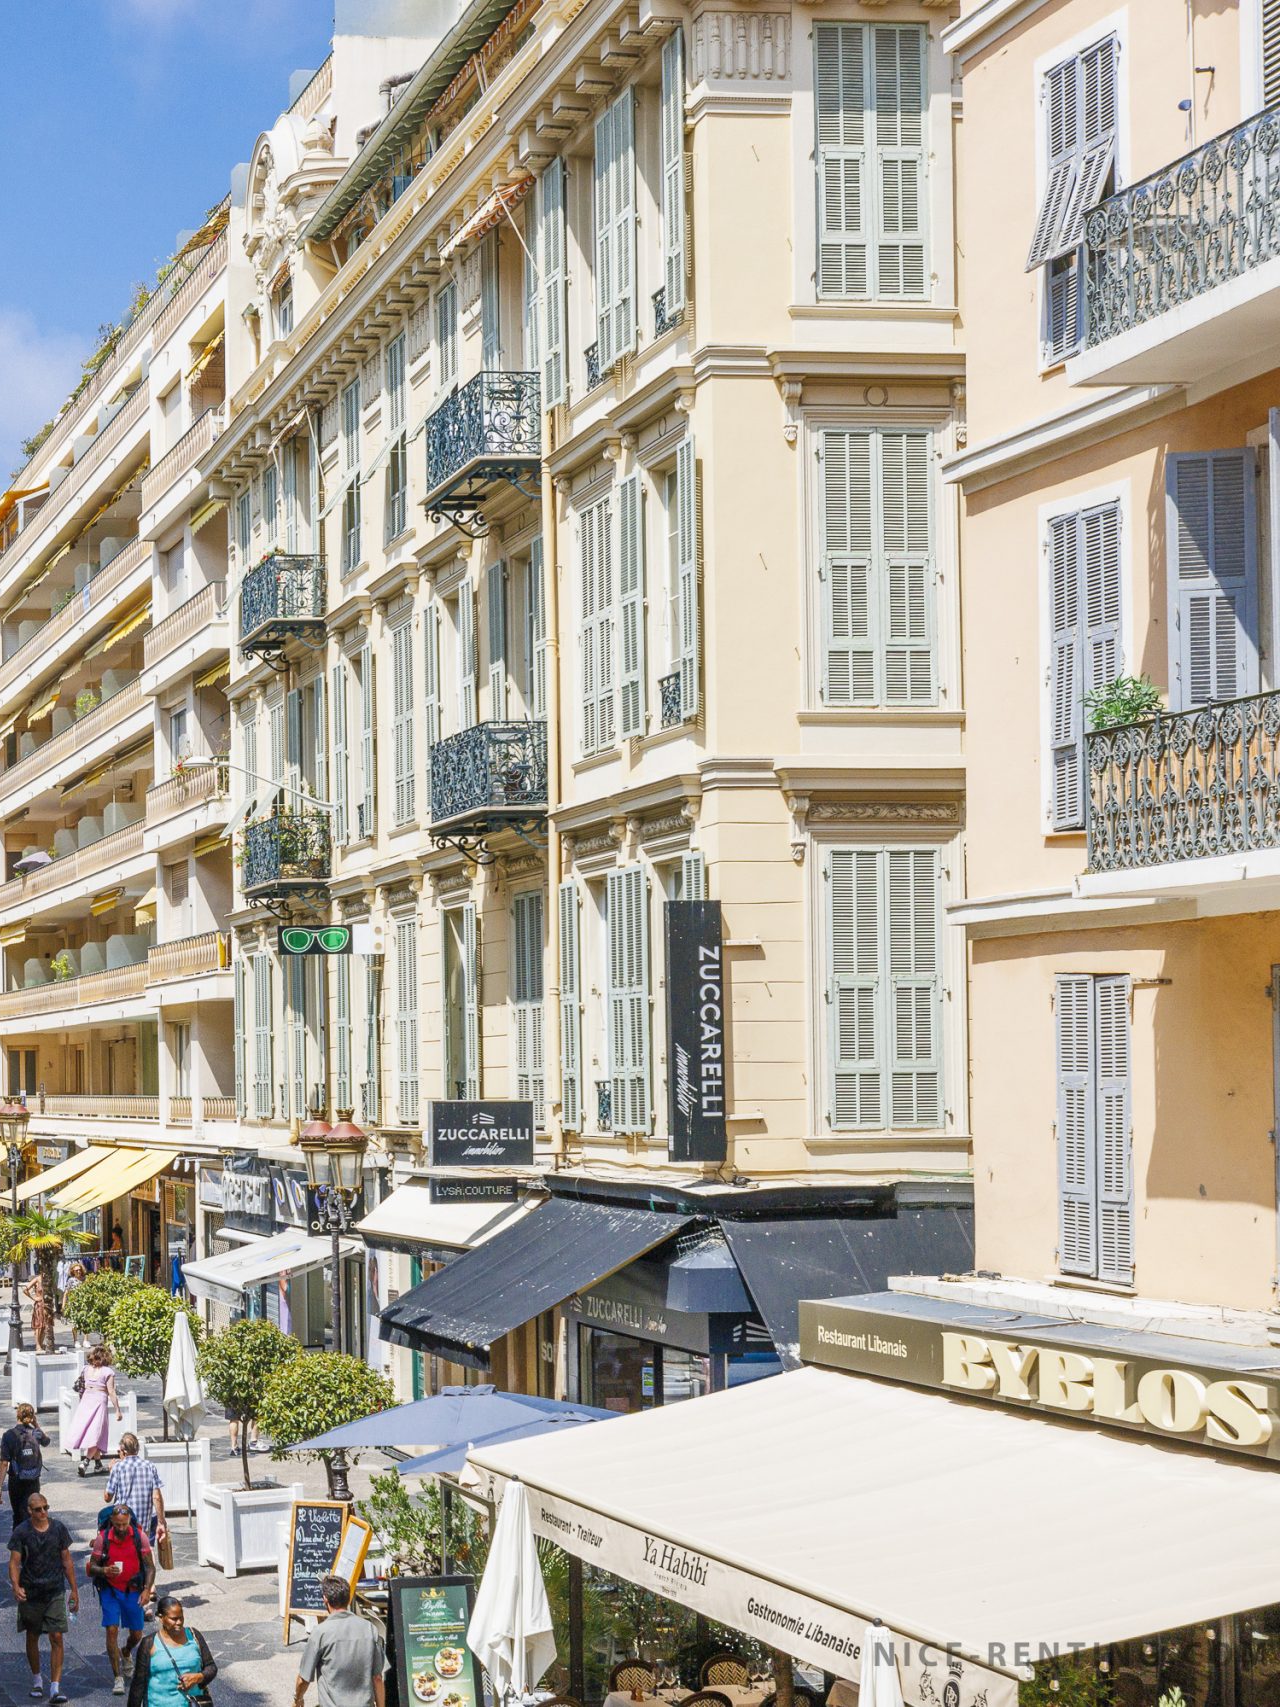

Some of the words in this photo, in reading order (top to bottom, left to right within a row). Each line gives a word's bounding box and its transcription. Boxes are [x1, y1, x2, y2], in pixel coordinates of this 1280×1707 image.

[698, 945, 723, 1117] ZUCCARELLI
[438, 1128, 529, 1140] ZUCCARELLI
[587, 1296, 643, 1329] ZUCCARELLI
[817, 1325, 866, 1350] Restaurant
[867, 1333, 907, 1358] Libanais
[940, 1331, 1272, 1446] BYBLOS
[541, 1507, 572, 1535] Restaurant
[577, 1524, 603, 1548] Traiteur
[643, 1536, 657, 1565] Ya
[658, 1543, 709, 1586] Habibi
[747, 1597, 805, 1636] Gastronomie
[805, 1621, 861, 1661] Libanaise
